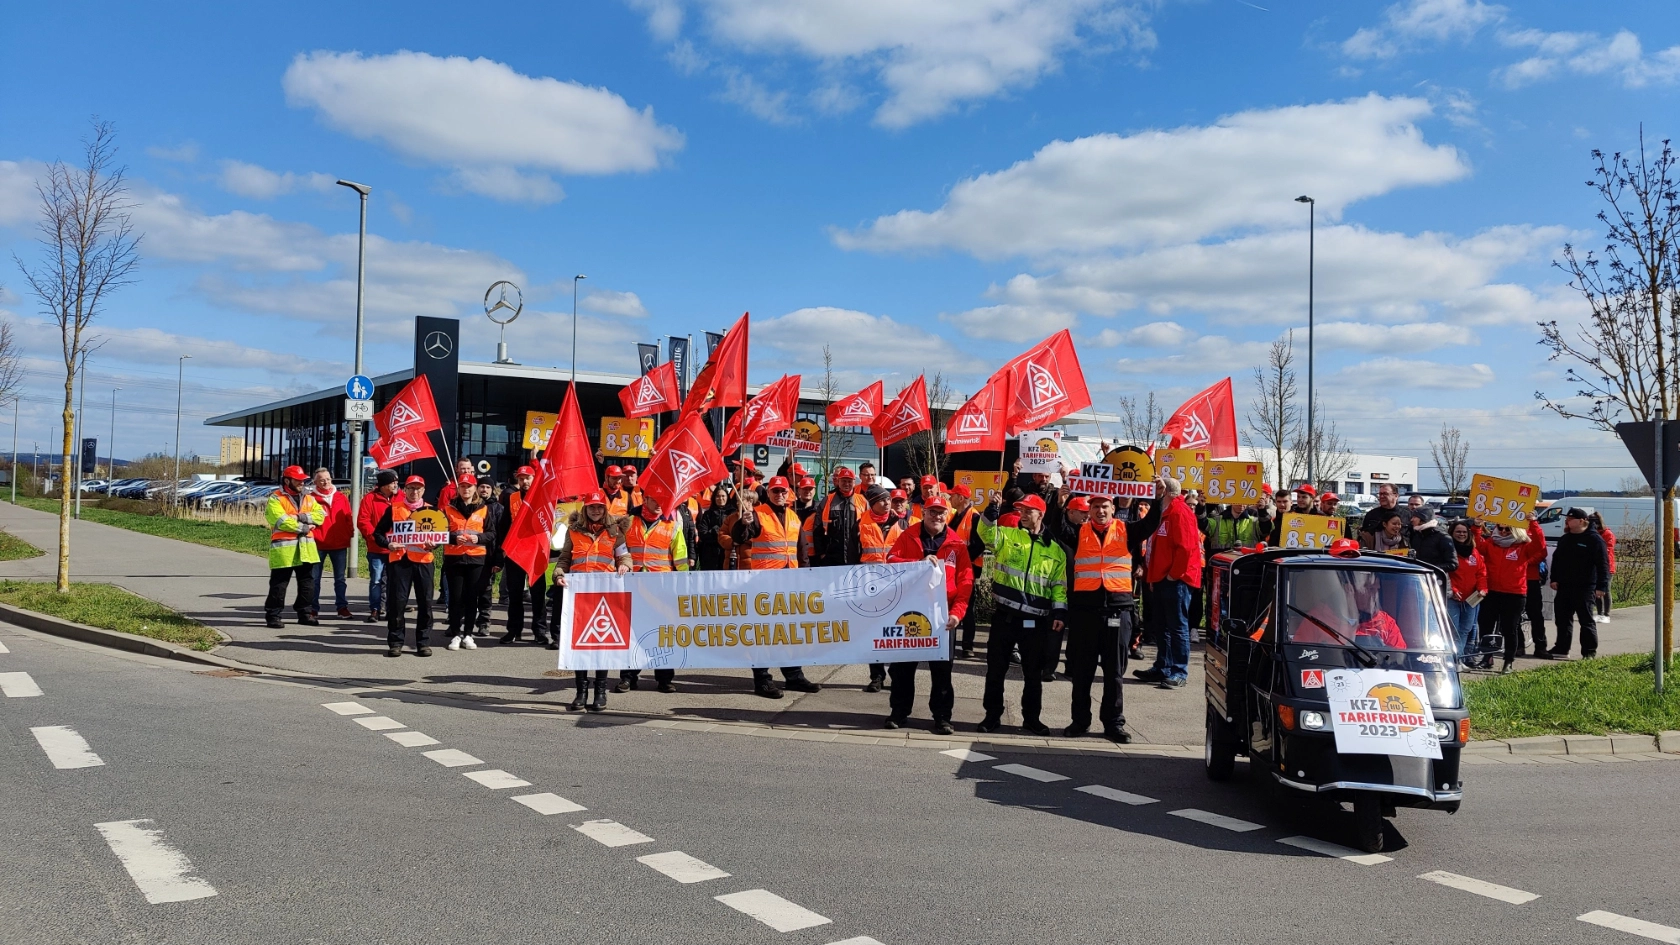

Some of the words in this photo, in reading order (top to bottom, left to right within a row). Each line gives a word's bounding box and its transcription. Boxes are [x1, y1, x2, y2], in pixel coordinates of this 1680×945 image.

[606, 434, 630, 452] 8,5
[634, 435, 648, 452] %
[768, 438, 820, 452] TARIFRUNDE
[1082, 464, 1110, 479] KFZ
[1068, 478, 1154, 496] TARIFRUNDE
[1208, 478, 1236, 500] 8,5
[1240, 480, 1257, 498] %
[1474, 494, 1504, 516] 8,5
[1508, 500, 1526, 522] %
[395, 522, 413, 533] KFZ
[388, 533, 448, 544] TARIFRUNDE
[678, 593, 748, 618] EINEN
[754, 590, 826, 616] GANG
[658, 620, 850, 648] HOCHSCHALTEN
[882, 626, 903, 637] KFZ
[873, 638, 939, 649] TARIFRUNDE
[1350, 699, 1378, 710] KFZ
[1338, 712, 1426, 727] TARIFRUNDE
[1358, 724, 1398, 736] 2023
